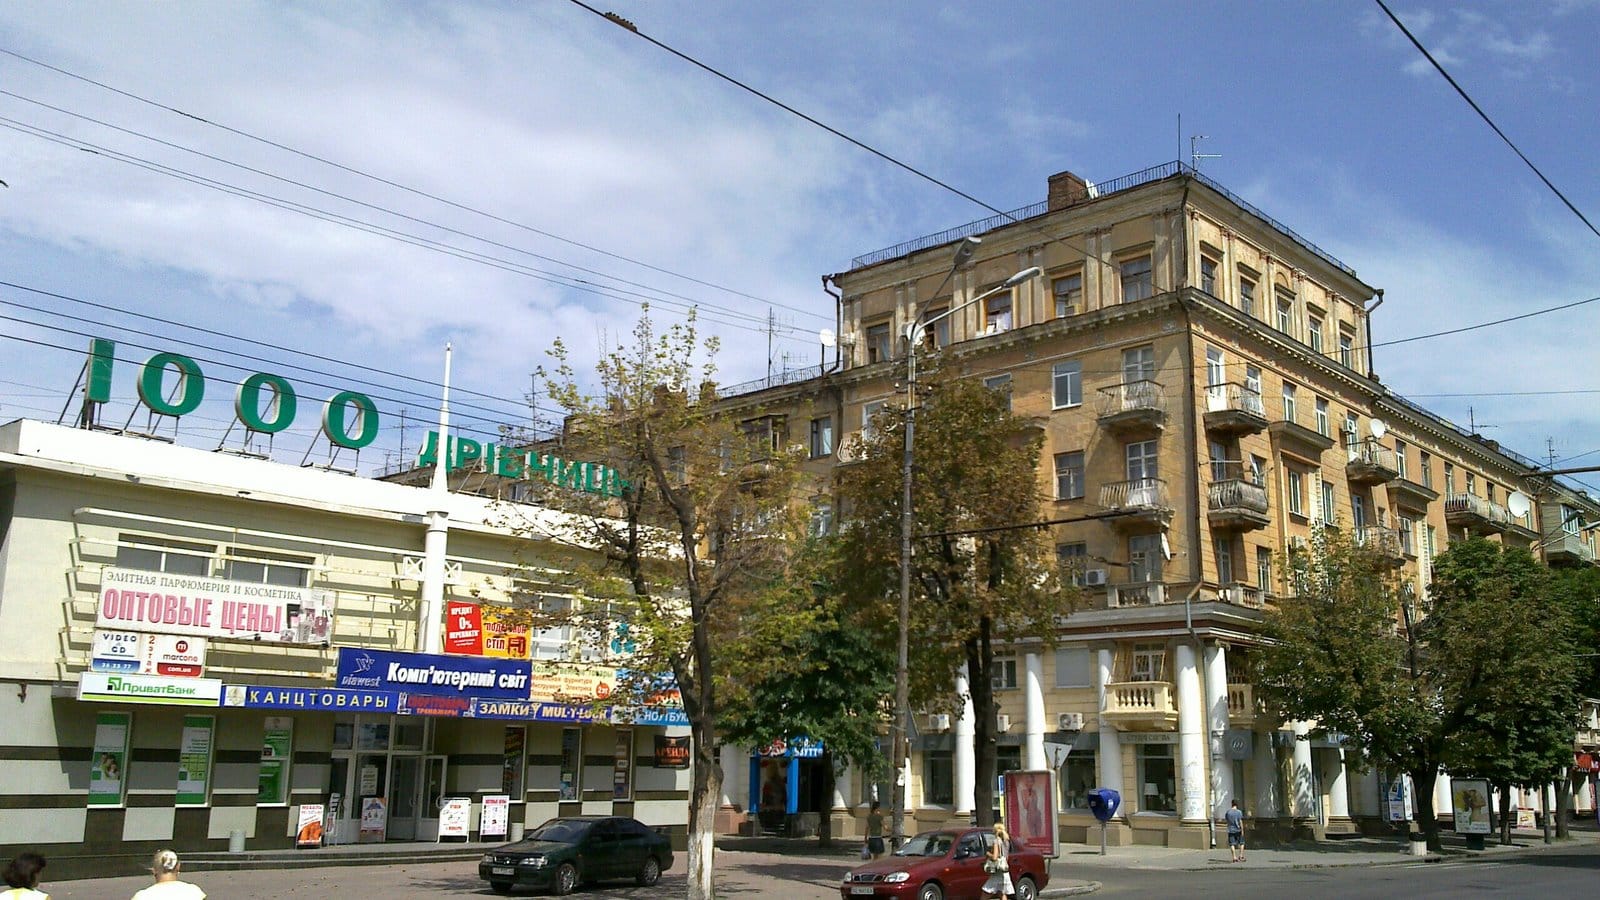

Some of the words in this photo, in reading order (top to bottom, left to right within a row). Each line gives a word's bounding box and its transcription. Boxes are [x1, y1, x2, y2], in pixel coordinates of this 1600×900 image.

[88, 338, 380, 449] 1000
[106, 570, 157, 587] ЭЛИТНАЯ
[160, 578, 230, 594] ПАРФЮМЕРИЯ
[233, 584, 241, 595] И
[244, 585, 302, 601] КОСМЕТИКА
[103, 587, 214, 628] ОПТОВЫЕ
[221, 599, 283, 635] ЦЕНЫ
[459, 616, 472, 630] 0%
[103, 633, 137, 642] VIDEO
[148, 635, 155, 645] 2
[111, 646, 126, 654] CD
[386, 662, 496, 690] Комп'ютерний
[498, 669, 528, 689] світ
[121, 681, 196, 695] ПриватБанк
[250, 690, 389, 708] КАНЦТОВАРЫ
[479, 703, 530, 717] ЗАМКИ
[643, 710, 689, 724] НОУТБУК
